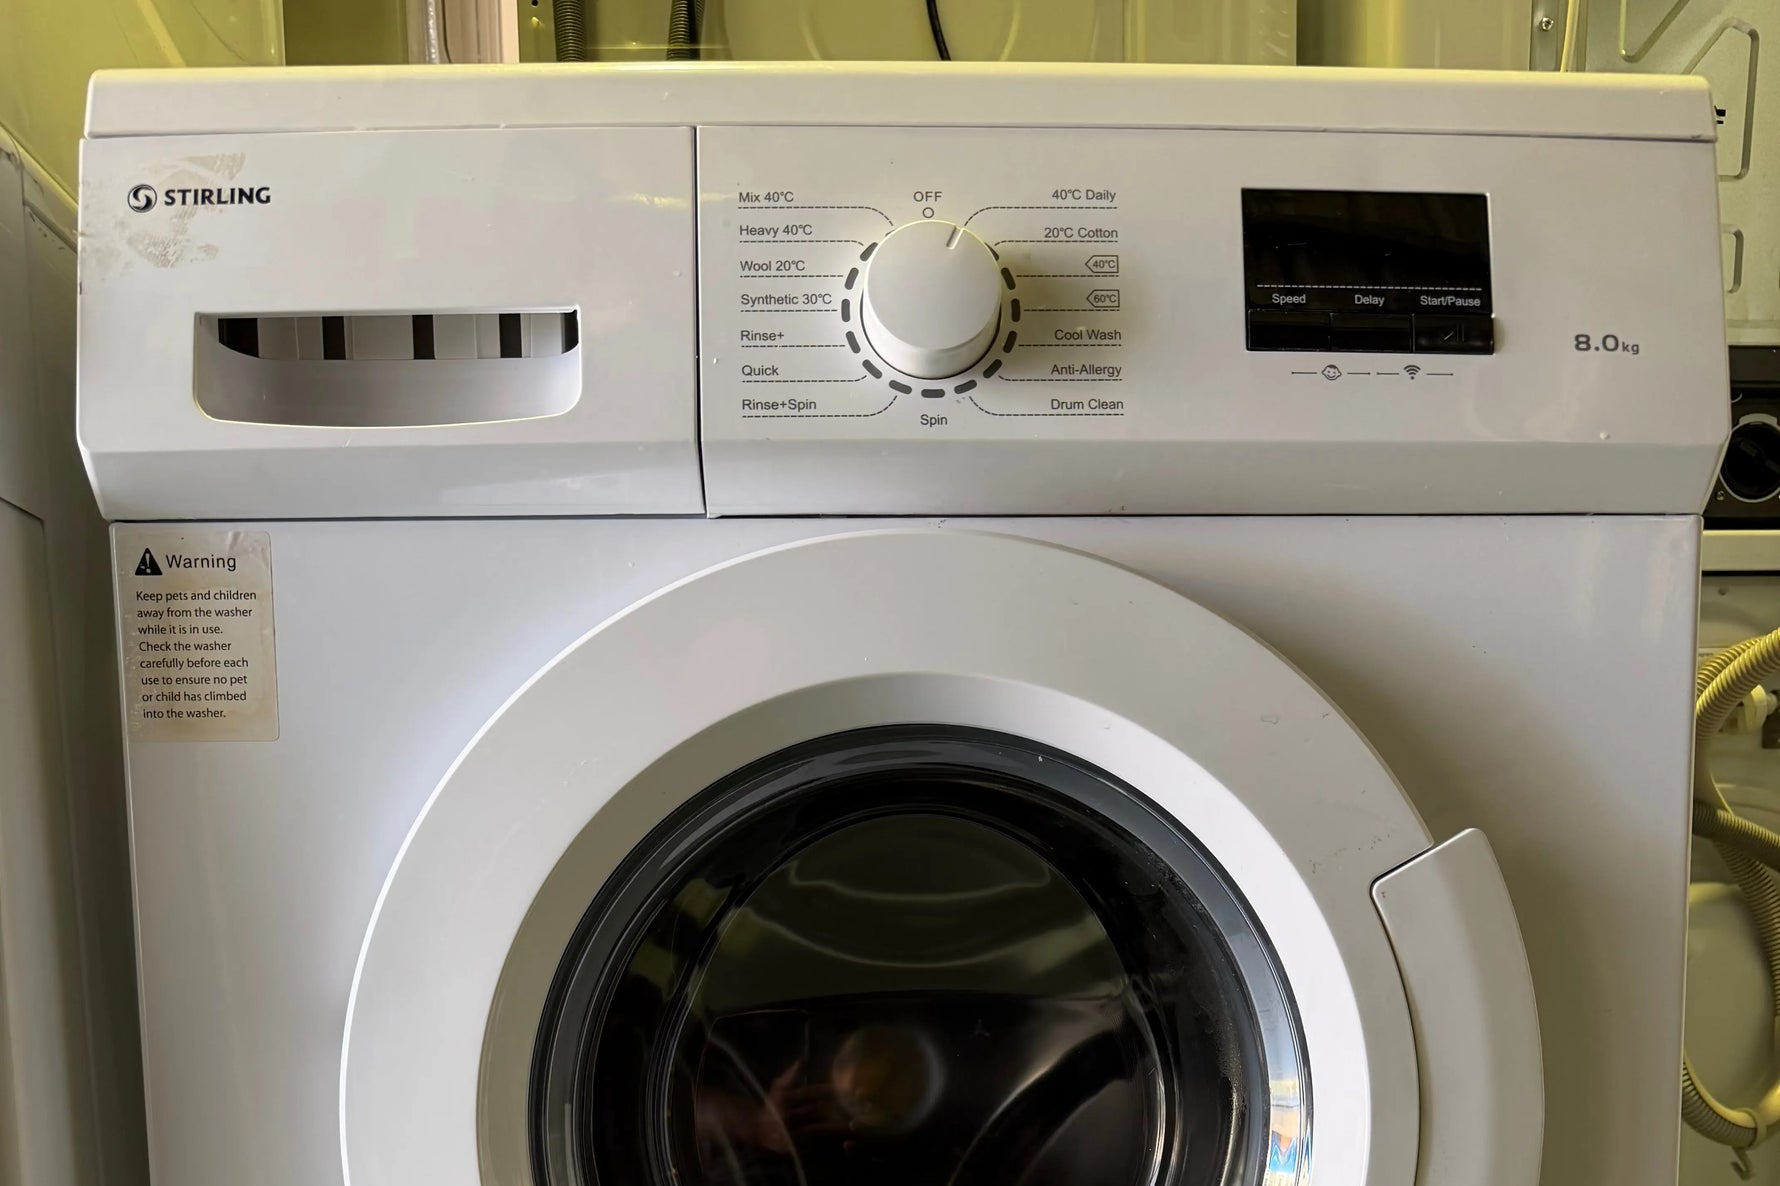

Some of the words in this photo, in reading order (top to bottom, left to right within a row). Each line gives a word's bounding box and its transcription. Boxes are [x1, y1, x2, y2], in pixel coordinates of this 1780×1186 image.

[164, 187, 271, 206] STIRLING
[739, 192, 761, 202] Mix
[914, 191, 942, 202] OFF
[1086, 189, 1116, 202] Daily
[739, 225, 779, 238] Heavy
[1077, 227, 1118, 238] Cotton
[740, 261, 772, 272] Wool
[741, 294, 799, 307] Synthetic
[1272, 293, 1306, 306] Speed
[1354, 295, 1384, 307] Delay
[1420, 296, 1481, 306] Start/Pause
[740, 330, 784, 341] Rinse+
[1054, 329, 1082, 341] Cool
[1088, 329, 1122, 340] Wash
[741, 365, 779, 377] Quick
[1051, 364, 1122, 376] Anti-Allergy
[742, 399, 817, 413] Rinse+Spin
[1051, 399, 1084, 410] Drum
[1088, 399, 1124, 409] Clean
[920, 414, 947, 427] Spin
[166, 554, 236, 571] Warning
[136, 592, 162, 603] Keep
[166, 592, 188, 602] pets
[191, 591, 210, 600] and
[214, 590, 256, 600] children
[137, 610, 164, 619] away
[167, 608, 191, 617] from
[195, 608, 212, 617] the
[215, 608, 252, 616] washer
[138, 625, 166, 634] while
[169, 625, 176, 634] it
[179, 625, 187, 634] is
[190, 625, 199, 634] in
[202, 626, 223, 634] use.
[139, 642, 171, 651] Check
[174, 642, 191, 651] the
[194, 642, 231, 650] washer
[140, 658, 184, 670] carefully
[187, 658, 221, 667] before
[224, 658, 248, 667] each
[141, 677, 160, 685] use
[162, 677, 172, 685] to
[176, 677, 210, 685] ensure
[214, 676, 227, 684] no
[230, 676, 247, 686] pet
[156, 692, 181, 701] child
[184, 692, 201, 701] has
[205, 691, 246, 701] climbed
[143, 709, 164, 719] into
[167, 709, 183, 718] the
[186, 708, 226, 718] washer.
